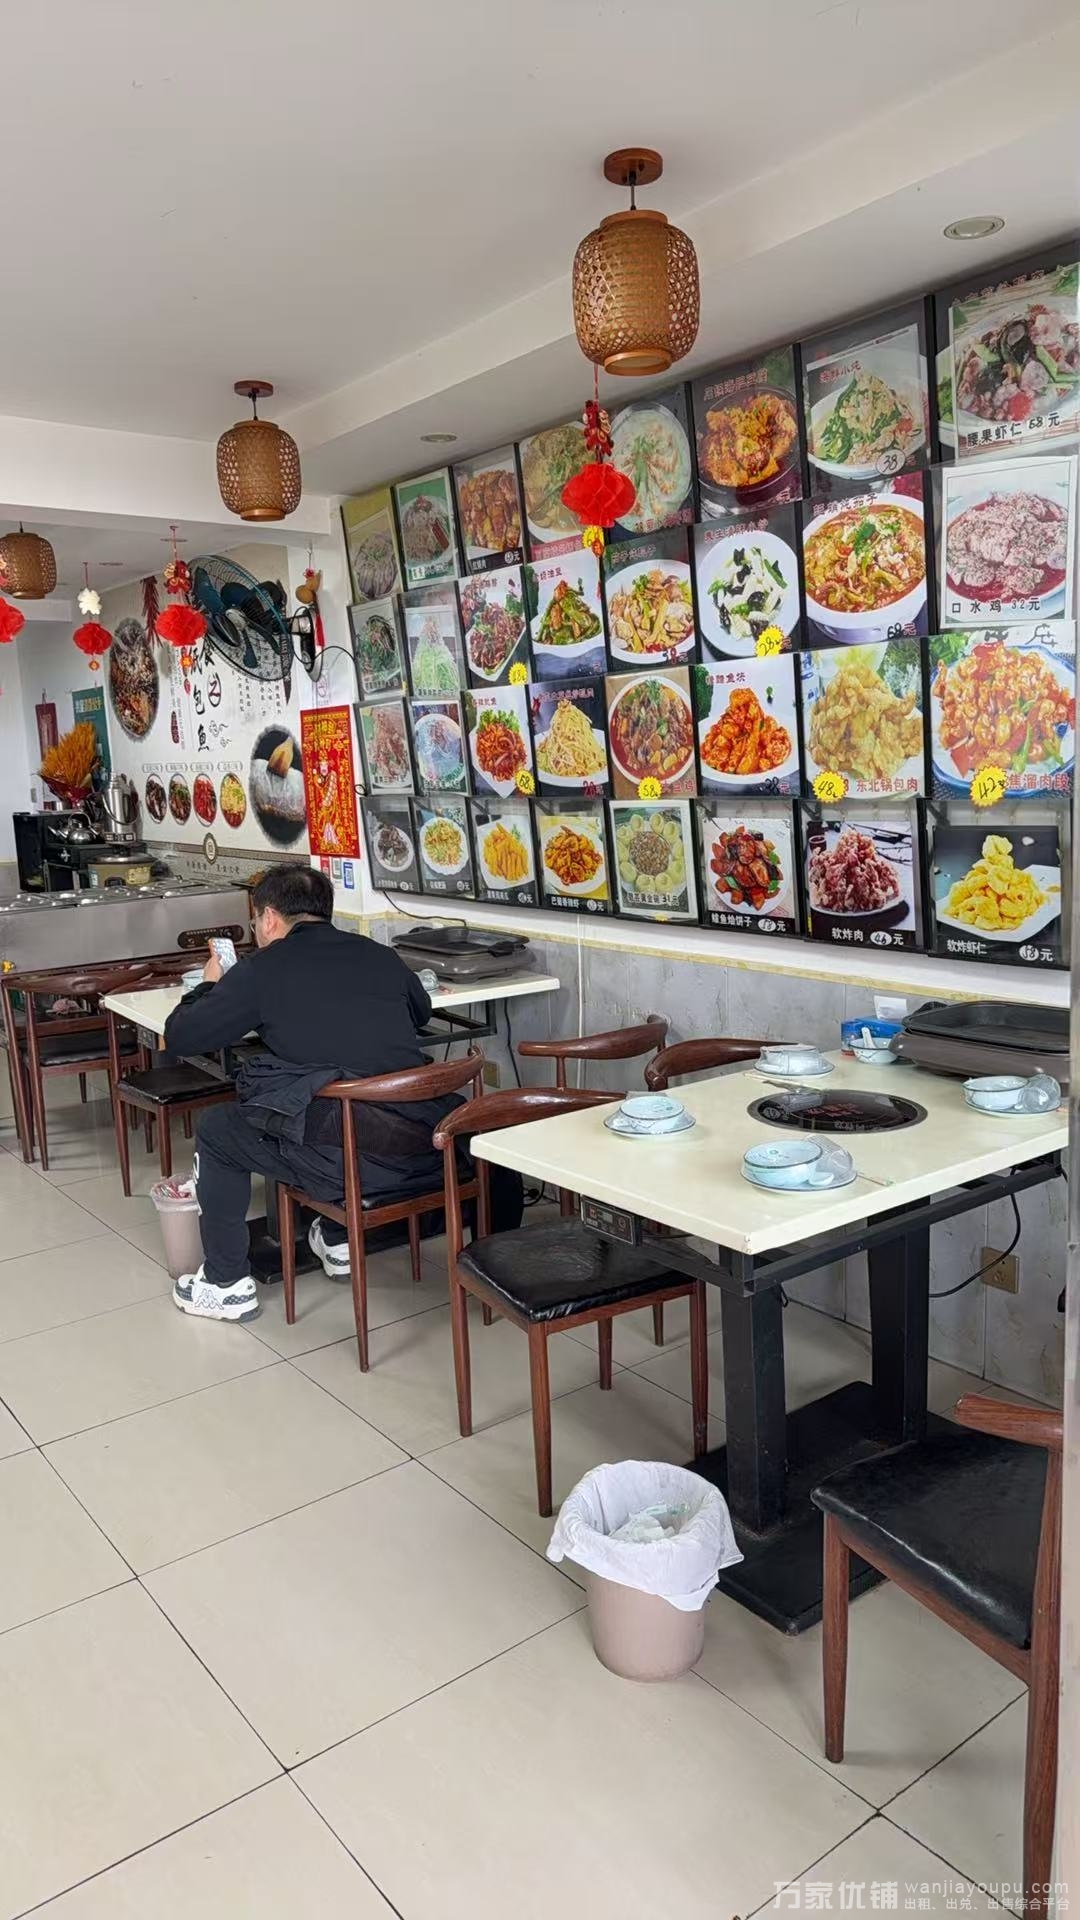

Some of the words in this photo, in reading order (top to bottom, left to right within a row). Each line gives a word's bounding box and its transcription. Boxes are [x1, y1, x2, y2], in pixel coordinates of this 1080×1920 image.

[967, 423, 1022, 447] 腰果虾仁
[952, 600, 1001, 613] 口水鸡
[856, 777, 918, 793] 东北锅包肉
[831, 927, 864, 942] 软炸肉
[946, 939, 988, 955] 软炸虾仁
